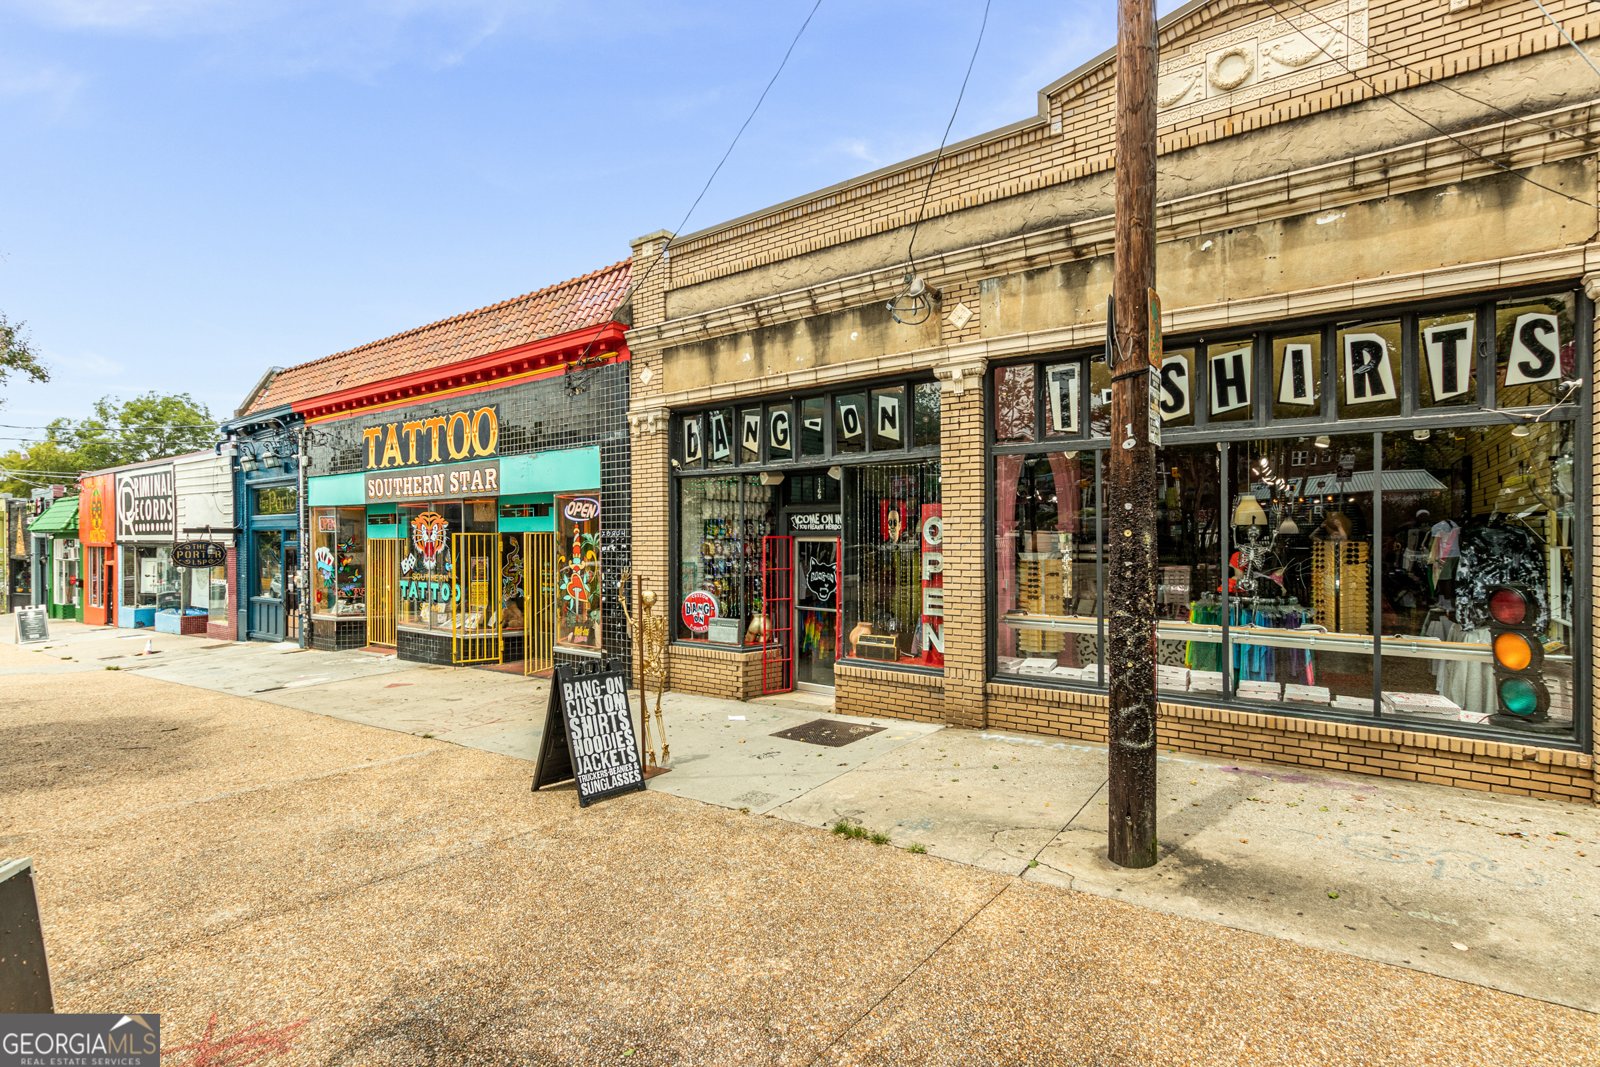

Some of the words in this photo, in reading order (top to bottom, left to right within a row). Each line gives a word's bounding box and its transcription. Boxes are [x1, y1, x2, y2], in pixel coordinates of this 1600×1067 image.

[362, 405, 498, 469] TATTOO
[368, 473, 445, 499] SOUTHERN
[449, 468, 498, 494] STAR
[567, 501, 597, 518] OPEN
[797, 513, 820, 525] COME
[821, 513, 834, 524] ON
[176, 550, 222, 559] PORTR
[411, 572, 449, 582] SOUTHERN
[563, 676, 624, 701] BANG-ON
[566, 693, 627, 719] CUSTOM
[569, 709, 630, 740] SHIRTS
[572, 729, 635, 758] HOODIES
[576, 745, 637, 775] JACKETS
[633, 761, 640, 770] &
[580, 769, 642, 796] SUNGLASSES
